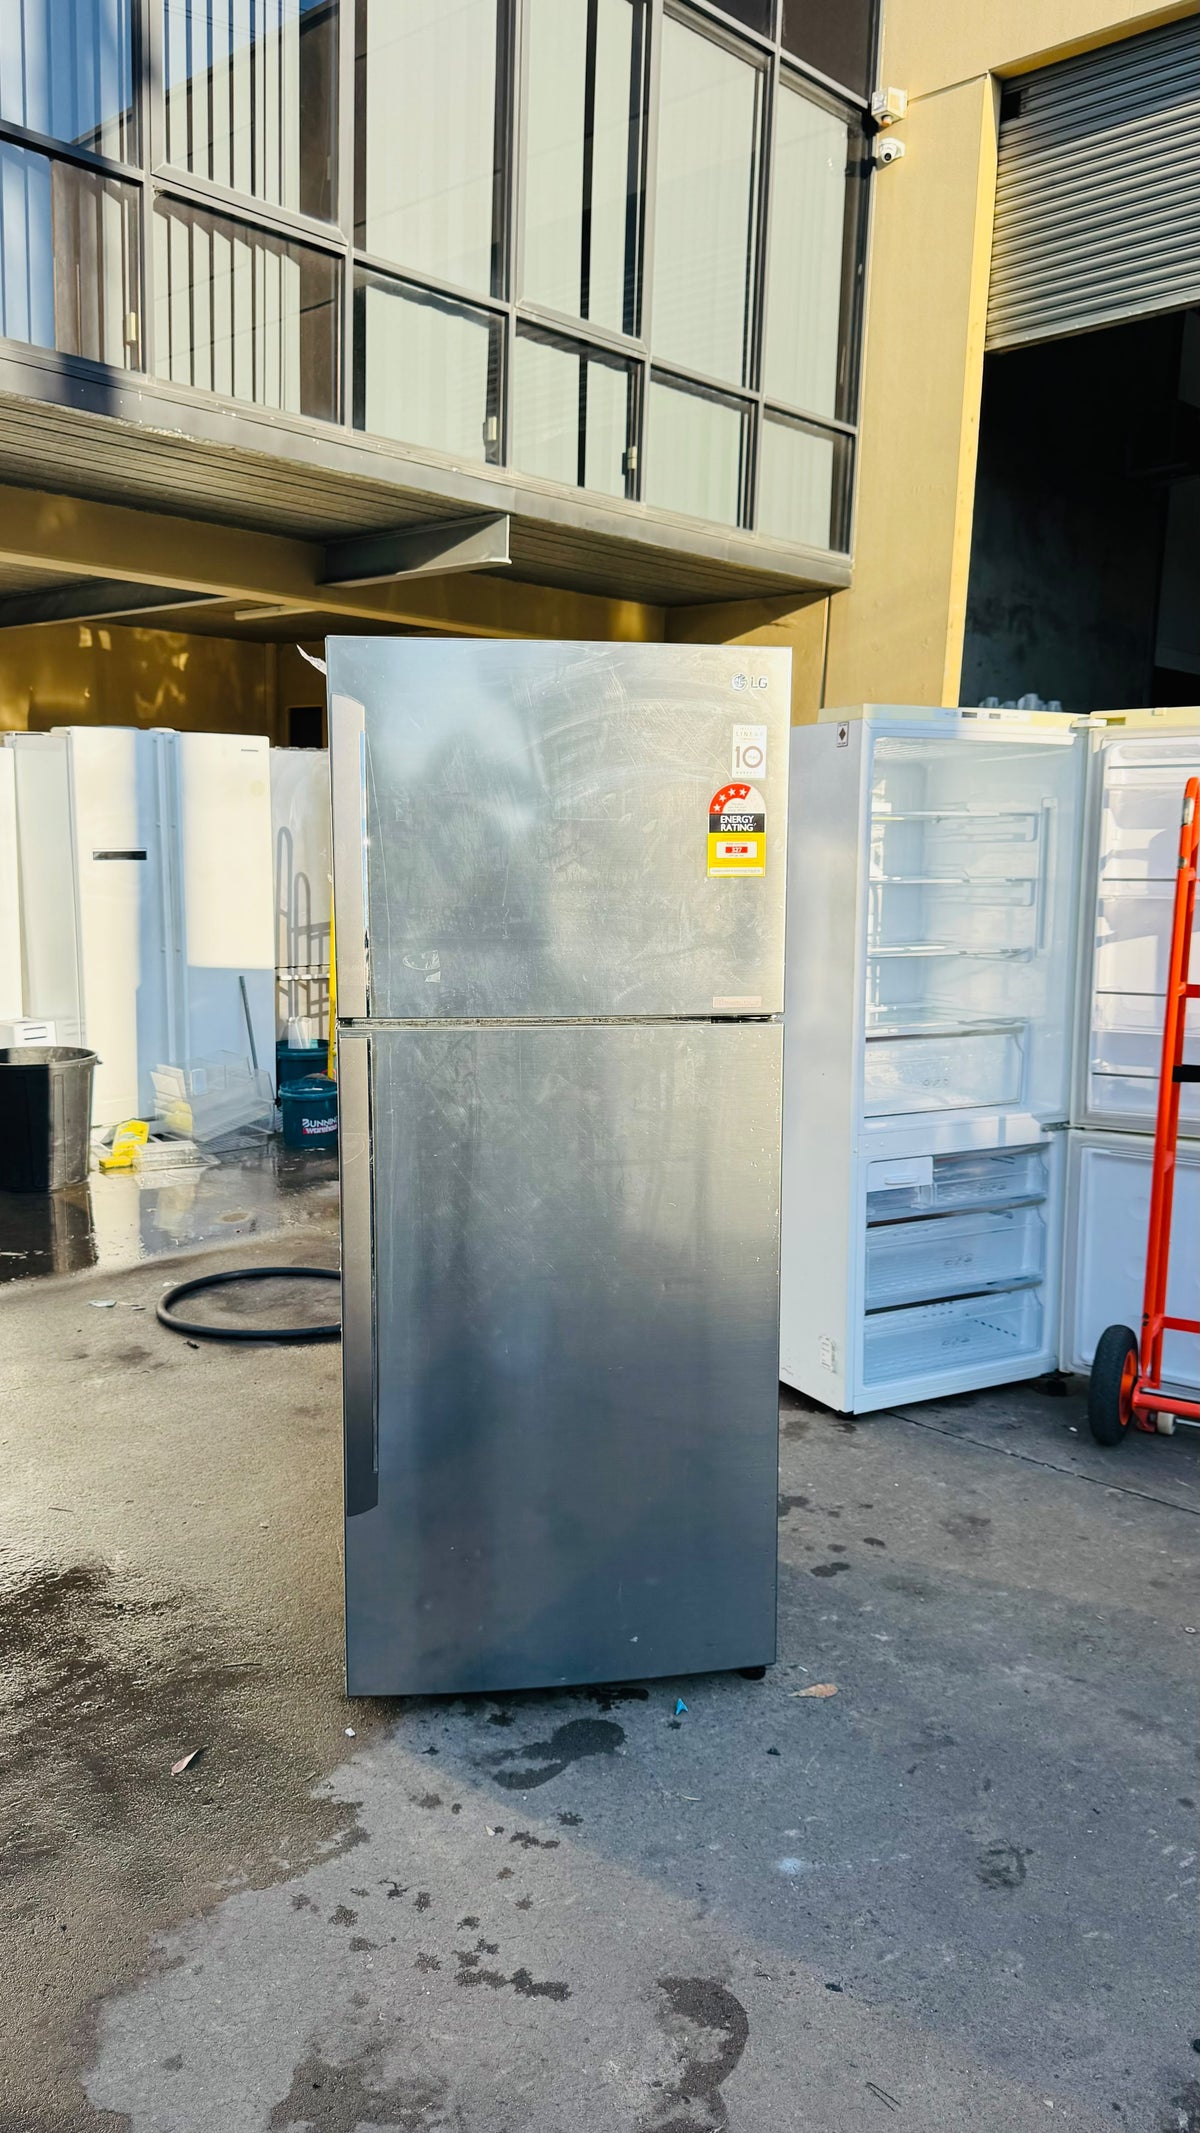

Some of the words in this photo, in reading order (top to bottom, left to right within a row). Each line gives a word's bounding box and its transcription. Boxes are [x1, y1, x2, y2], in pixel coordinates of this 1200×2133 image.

[750, 676, 768, 689] LG
[735, 745, 764, 769] 10
[720, 815, 755, 824] ENERGY
[720, 823, 754, 832] RATING
